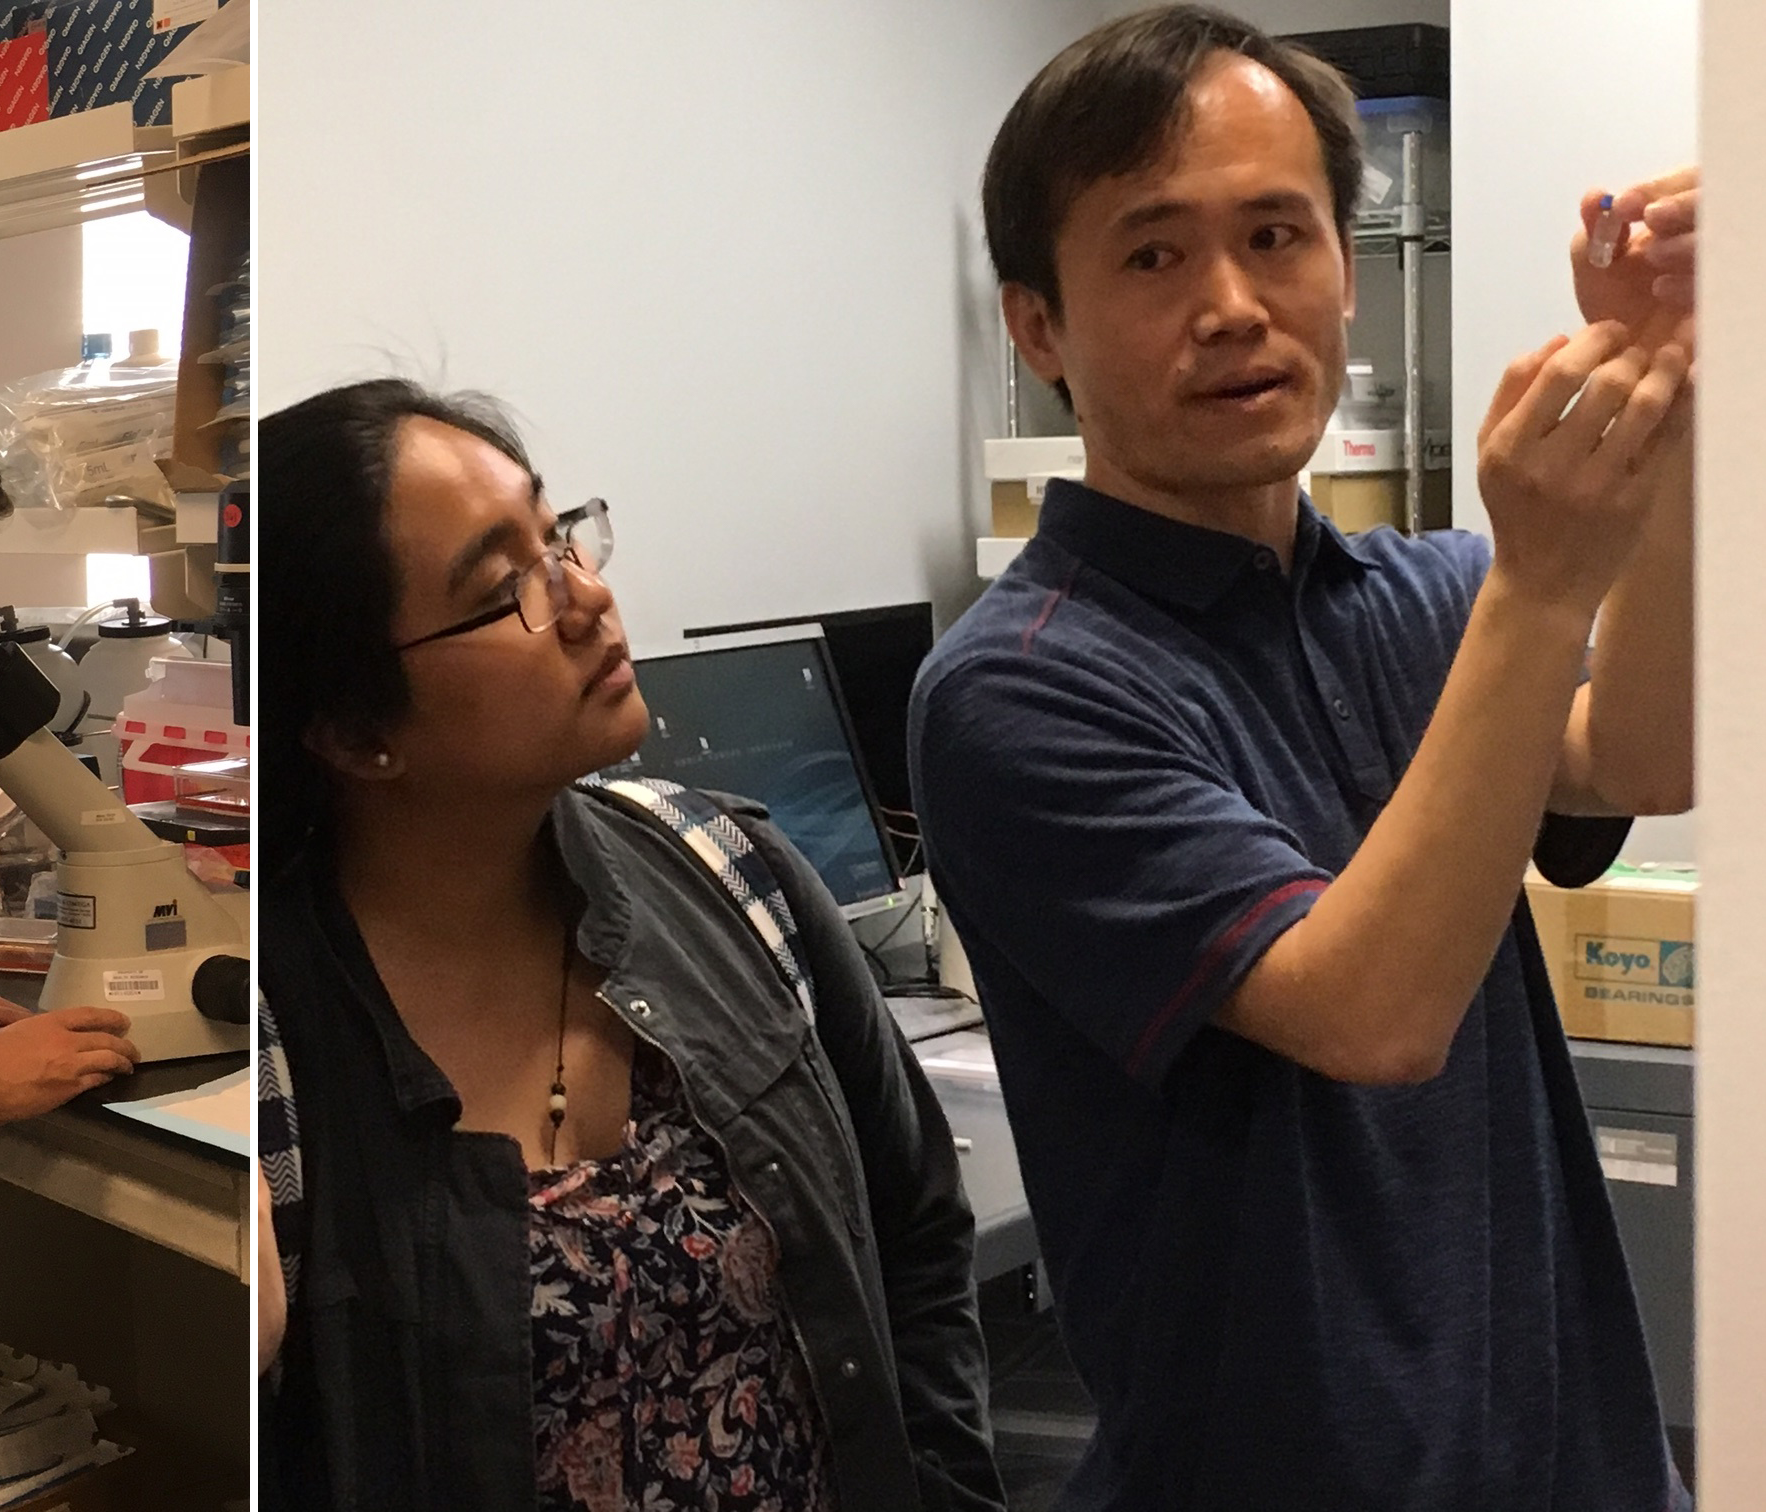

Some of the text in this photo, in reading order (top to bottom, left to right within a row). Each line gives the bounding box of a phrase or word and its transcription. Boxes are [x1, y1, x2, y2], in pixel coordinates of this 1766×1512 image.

[62, 5, 81, 37] QIAGEN
[102, 1, 122, 33] QIAGEN
[77, 23, 96, 55] QIAGEN
[118, 19, 139, 51] QIAGEN
[14, 47, 33, 77] QIAGEN
[54, 46, 72, 77] QIAGEN
[93, 41, 112, 74] QIAGEN
[135, 38, 156, 70] QIAGEN
[30, 64, 48, 95] QIAGEN
[69, 64, 87, 95] QIAGEN
[109, 60, 129, 92] QIAGEN
[7, 85, 24, 115] QIAGEN
[1343, 440, 1376, 456] Thermo
[1586, 941, 1651, 976] Koyo
[1584, 986, 1695, 1006] BEARINGS
